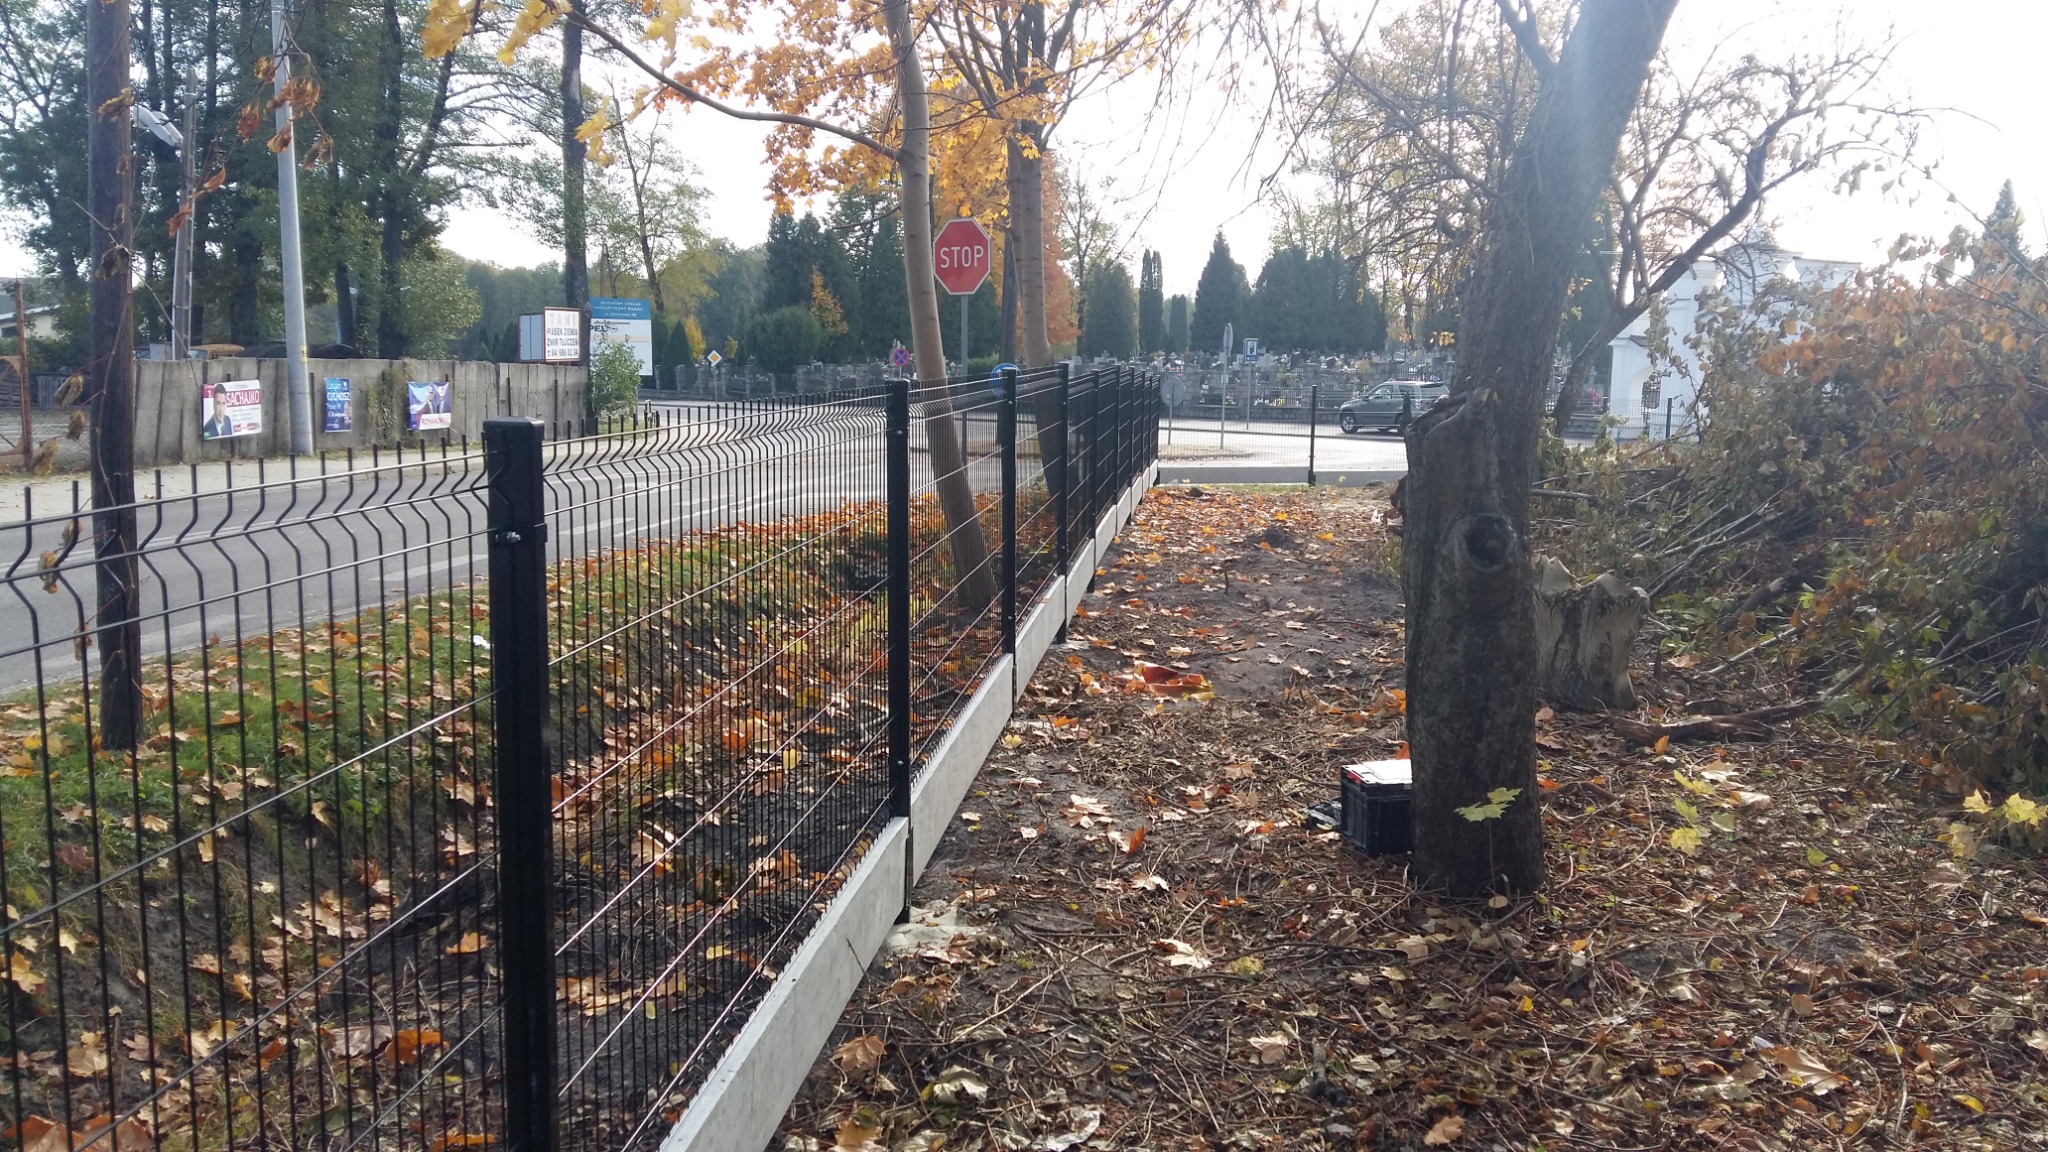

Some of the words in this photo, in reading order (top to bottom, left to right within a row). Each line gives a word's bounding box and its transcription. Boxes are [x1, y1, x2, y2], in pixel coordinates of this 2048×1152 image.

[940, 245, 984, 268] STOP
[549, 313, 576, 326] TANI
[227, 390, 260, 407] SACHAJKO
